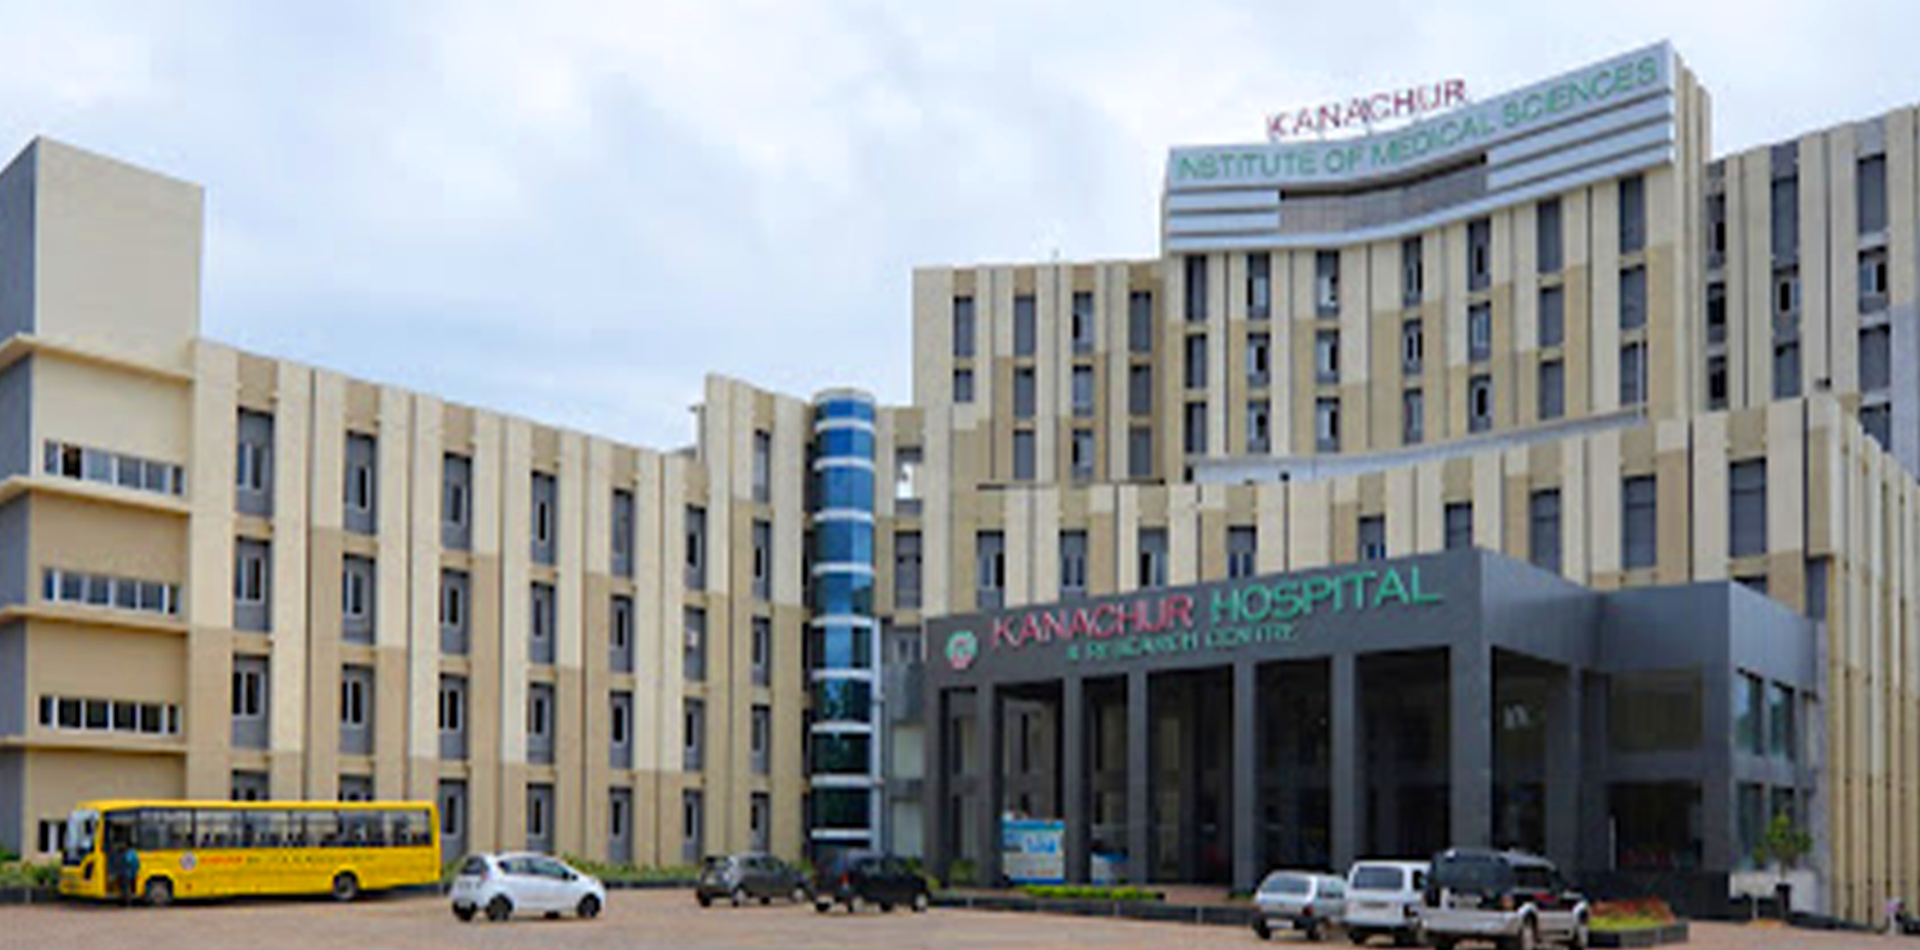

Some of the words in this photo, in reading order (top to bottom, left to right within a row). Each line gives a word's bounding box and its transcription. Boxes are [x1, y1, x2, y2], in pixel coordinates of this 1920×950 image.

[1176, 151, 1318, 181] INSTITUTE
[1324, 147, 1362, 174] OF
[1370, 114, 1496, 166] MEDICAL
[1502, 56, 1657, 128] SCIENCES
[1266, 78, 1466, 136] KANACHUR
[991, 593, 1194, 649] KANACHUR
[1209, 565, 1440, 625] HOSPITAL
